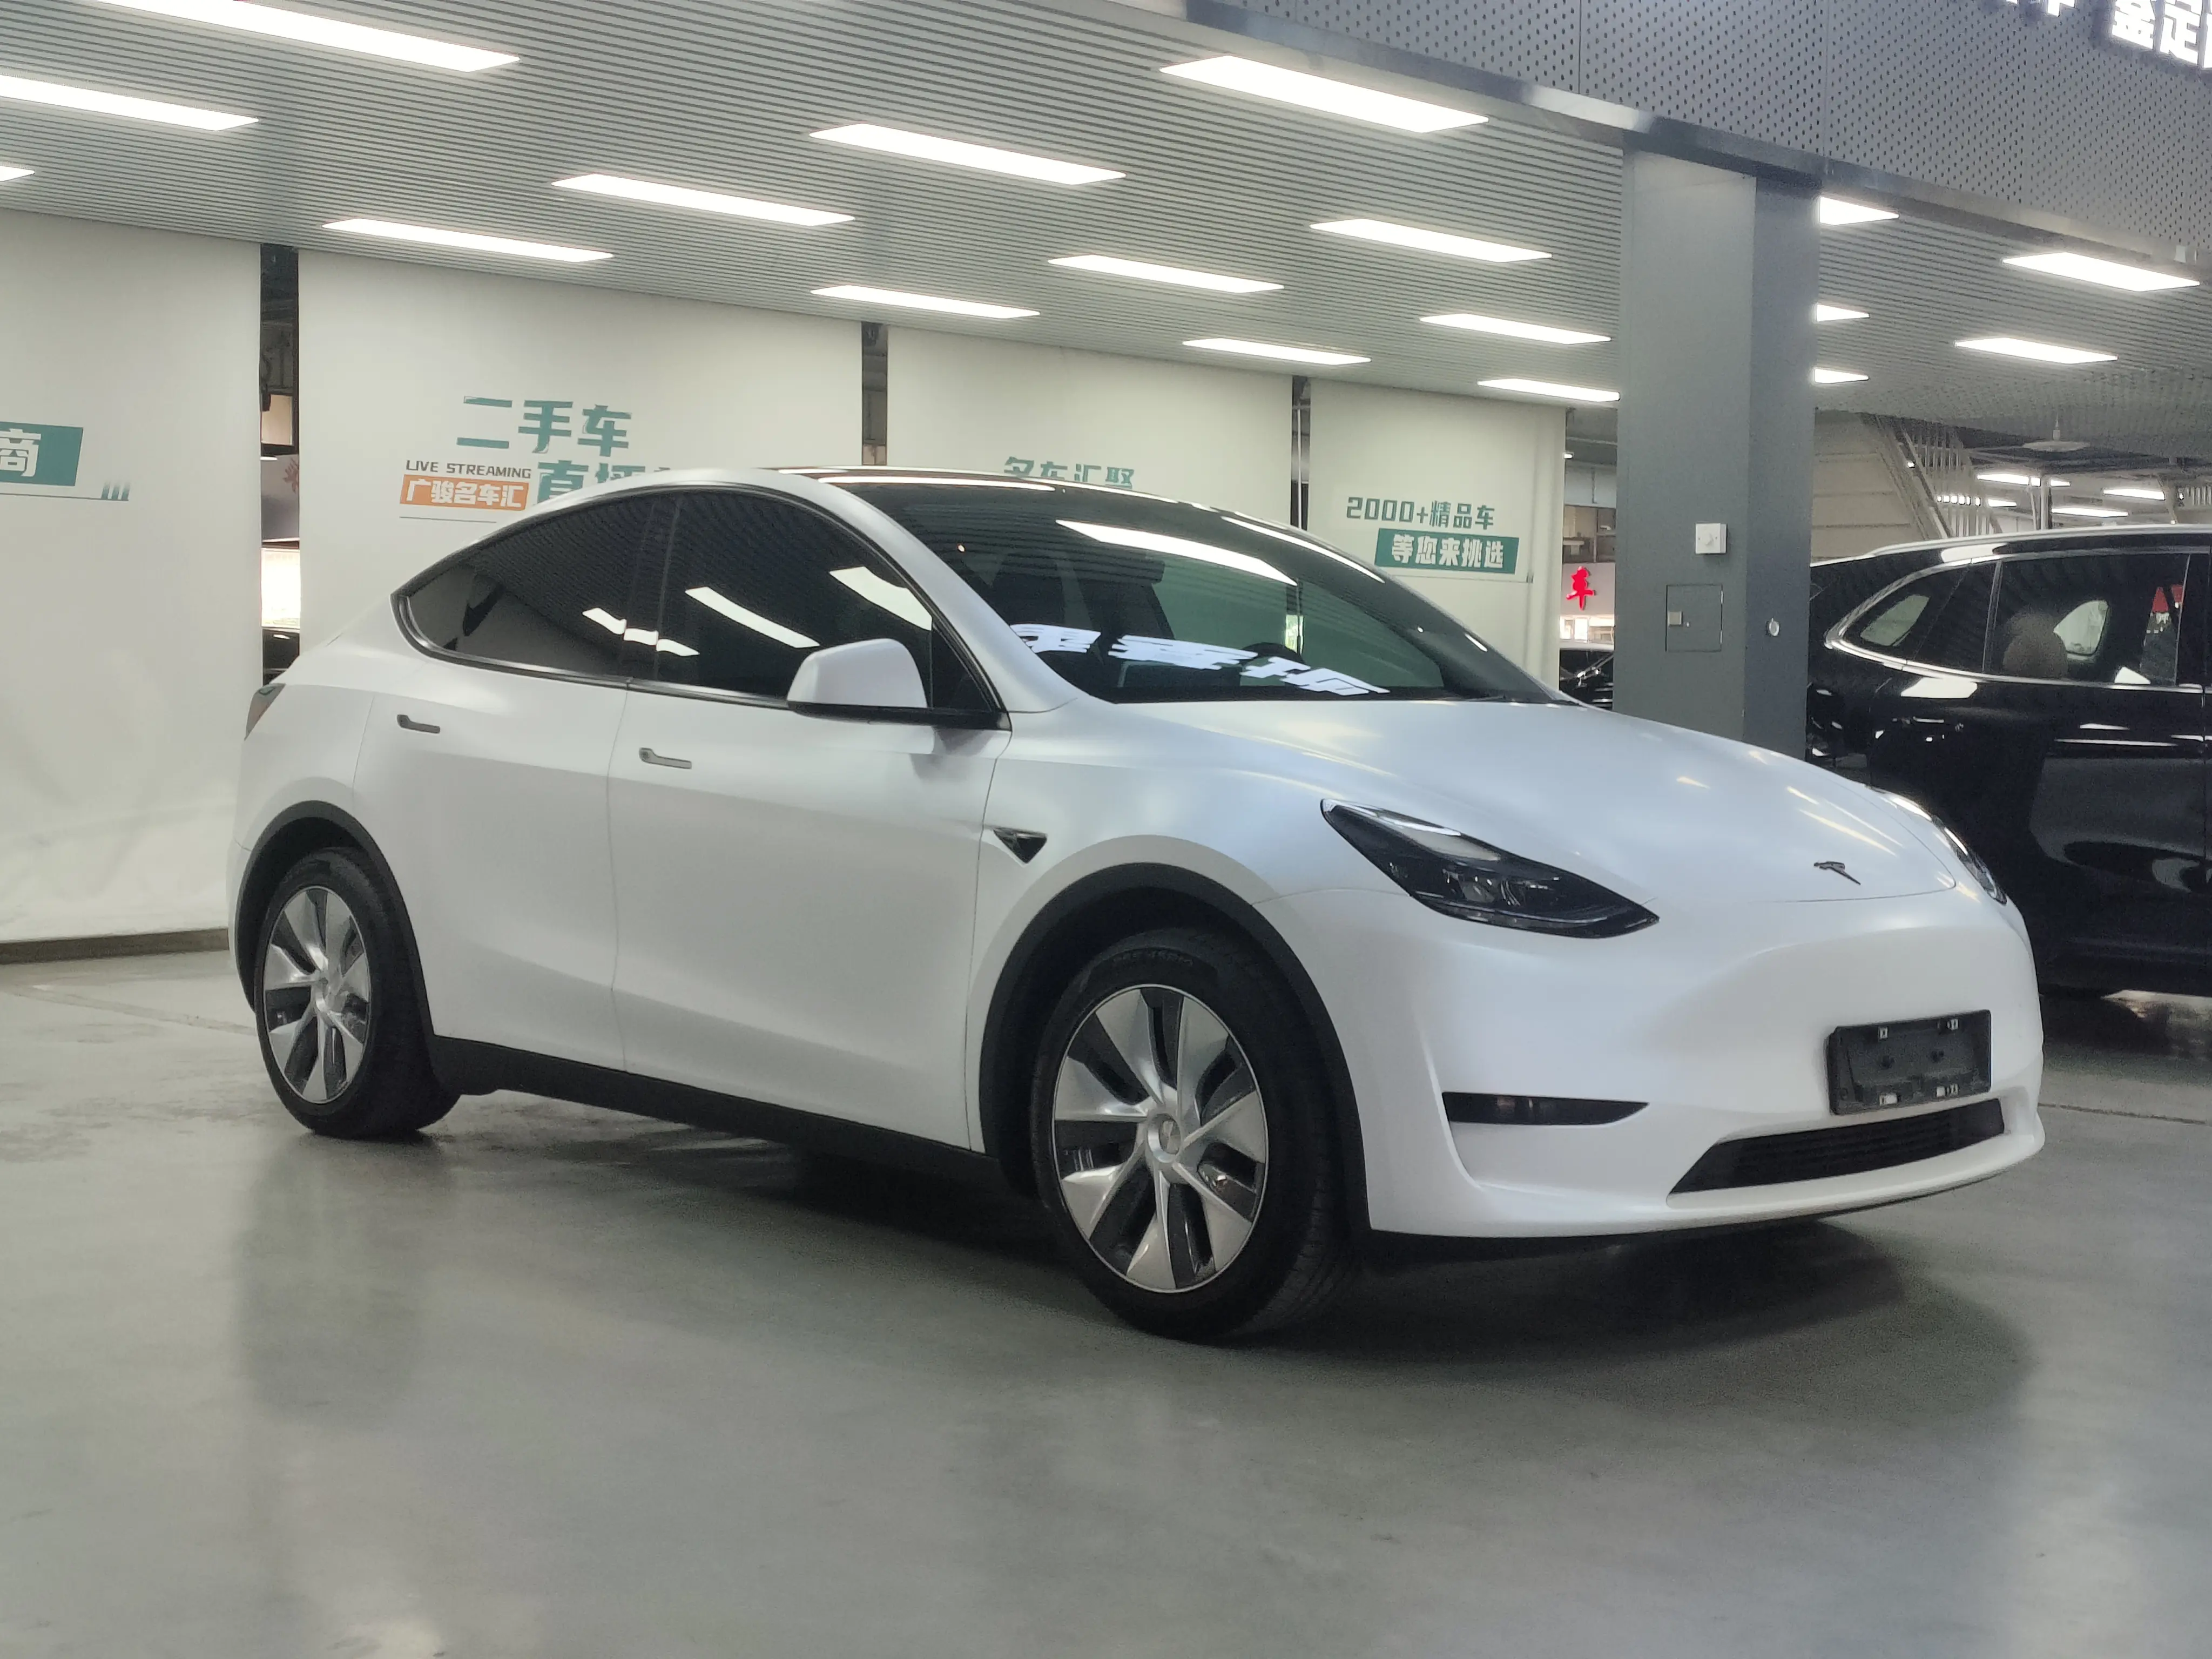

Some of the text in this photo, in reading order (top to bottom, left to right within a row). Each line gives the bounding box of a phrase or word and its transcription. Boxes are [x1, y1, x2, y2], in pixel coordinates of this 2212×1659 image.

[456, 396, 632, 457] 二手车
[406, 460, 531, 478] LIVE STREAMING
[406, 478, 524, 508] 广骏名车汇
[1346, 496, 1495, 530] 2000+精品车
[1391, 533, 1504, 569] 等您来挑选
